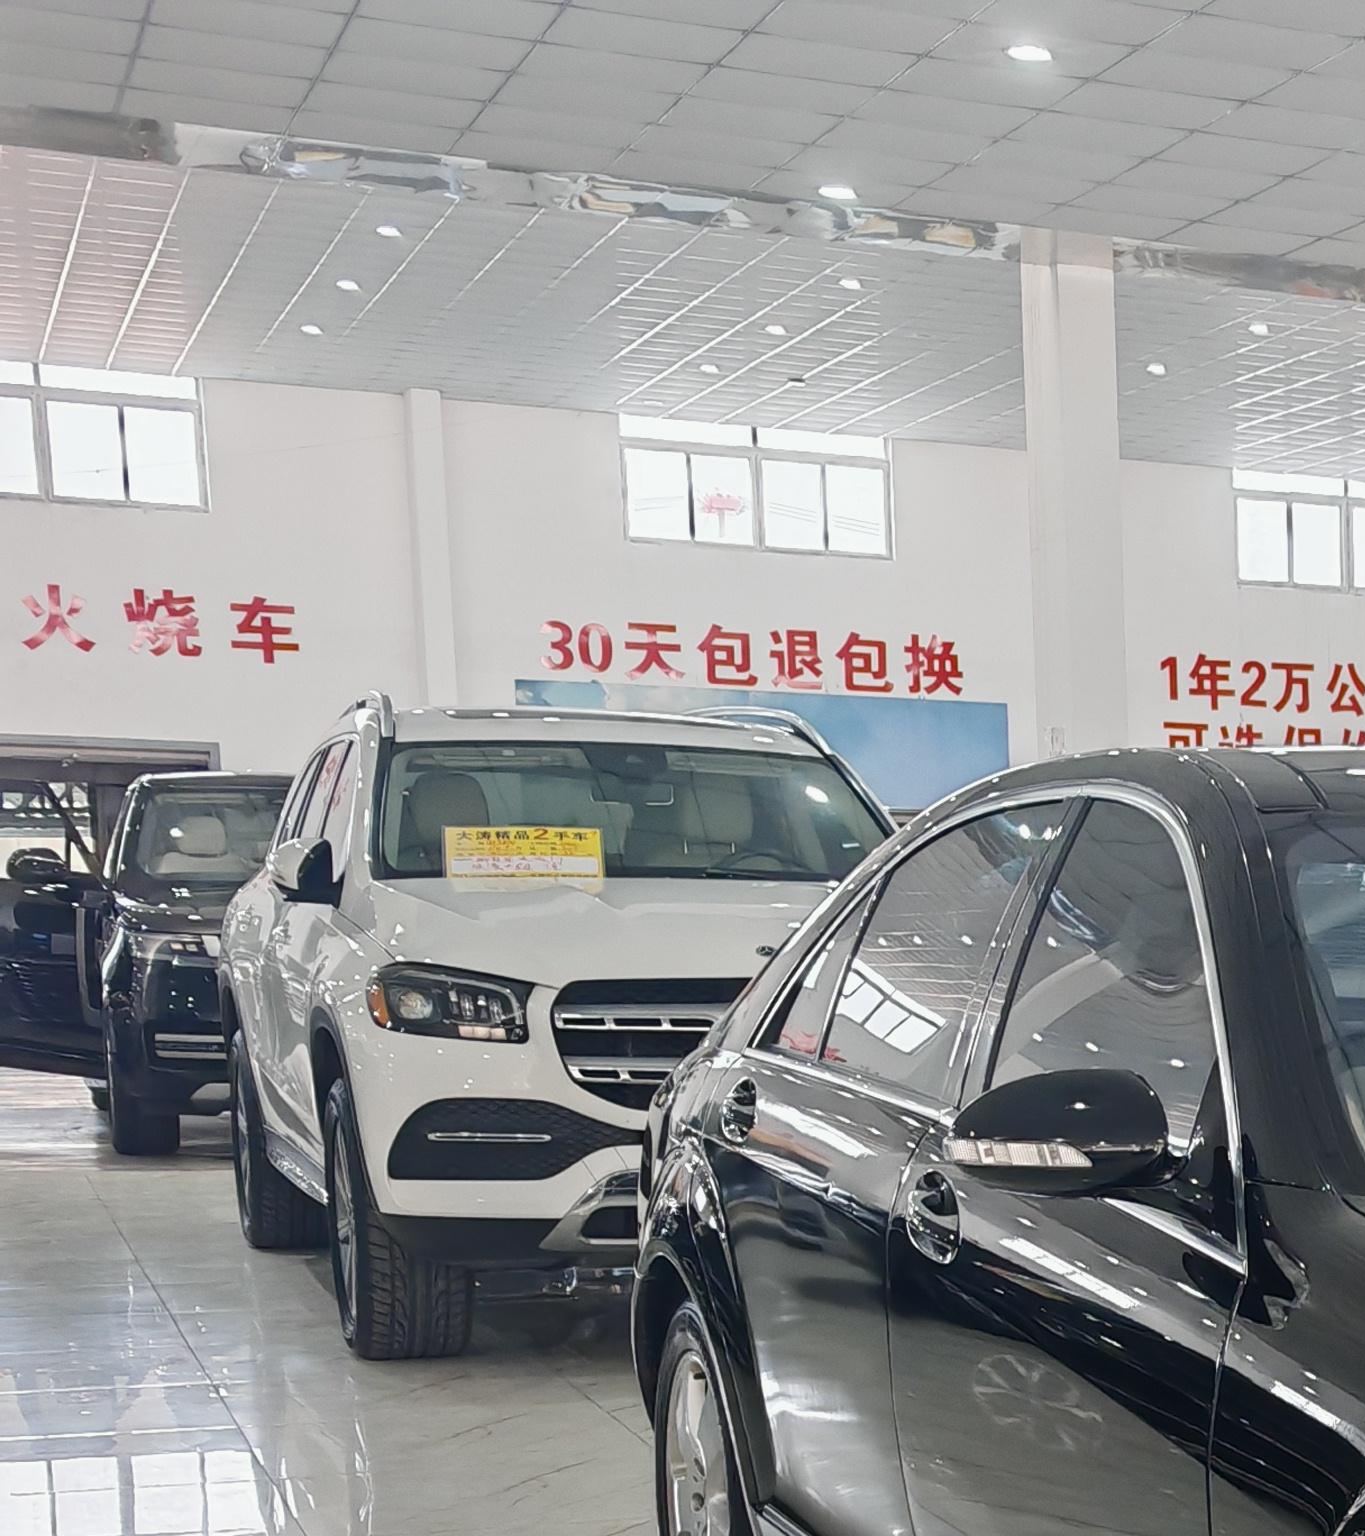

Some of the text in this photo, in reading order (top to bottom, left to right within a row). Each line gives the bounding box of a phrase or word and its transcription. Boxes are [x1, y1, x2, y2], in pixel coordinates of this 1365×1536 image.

[21, 583, 301, 664] 火烧车
[539, 619, 966, 696] 30天包退包换
